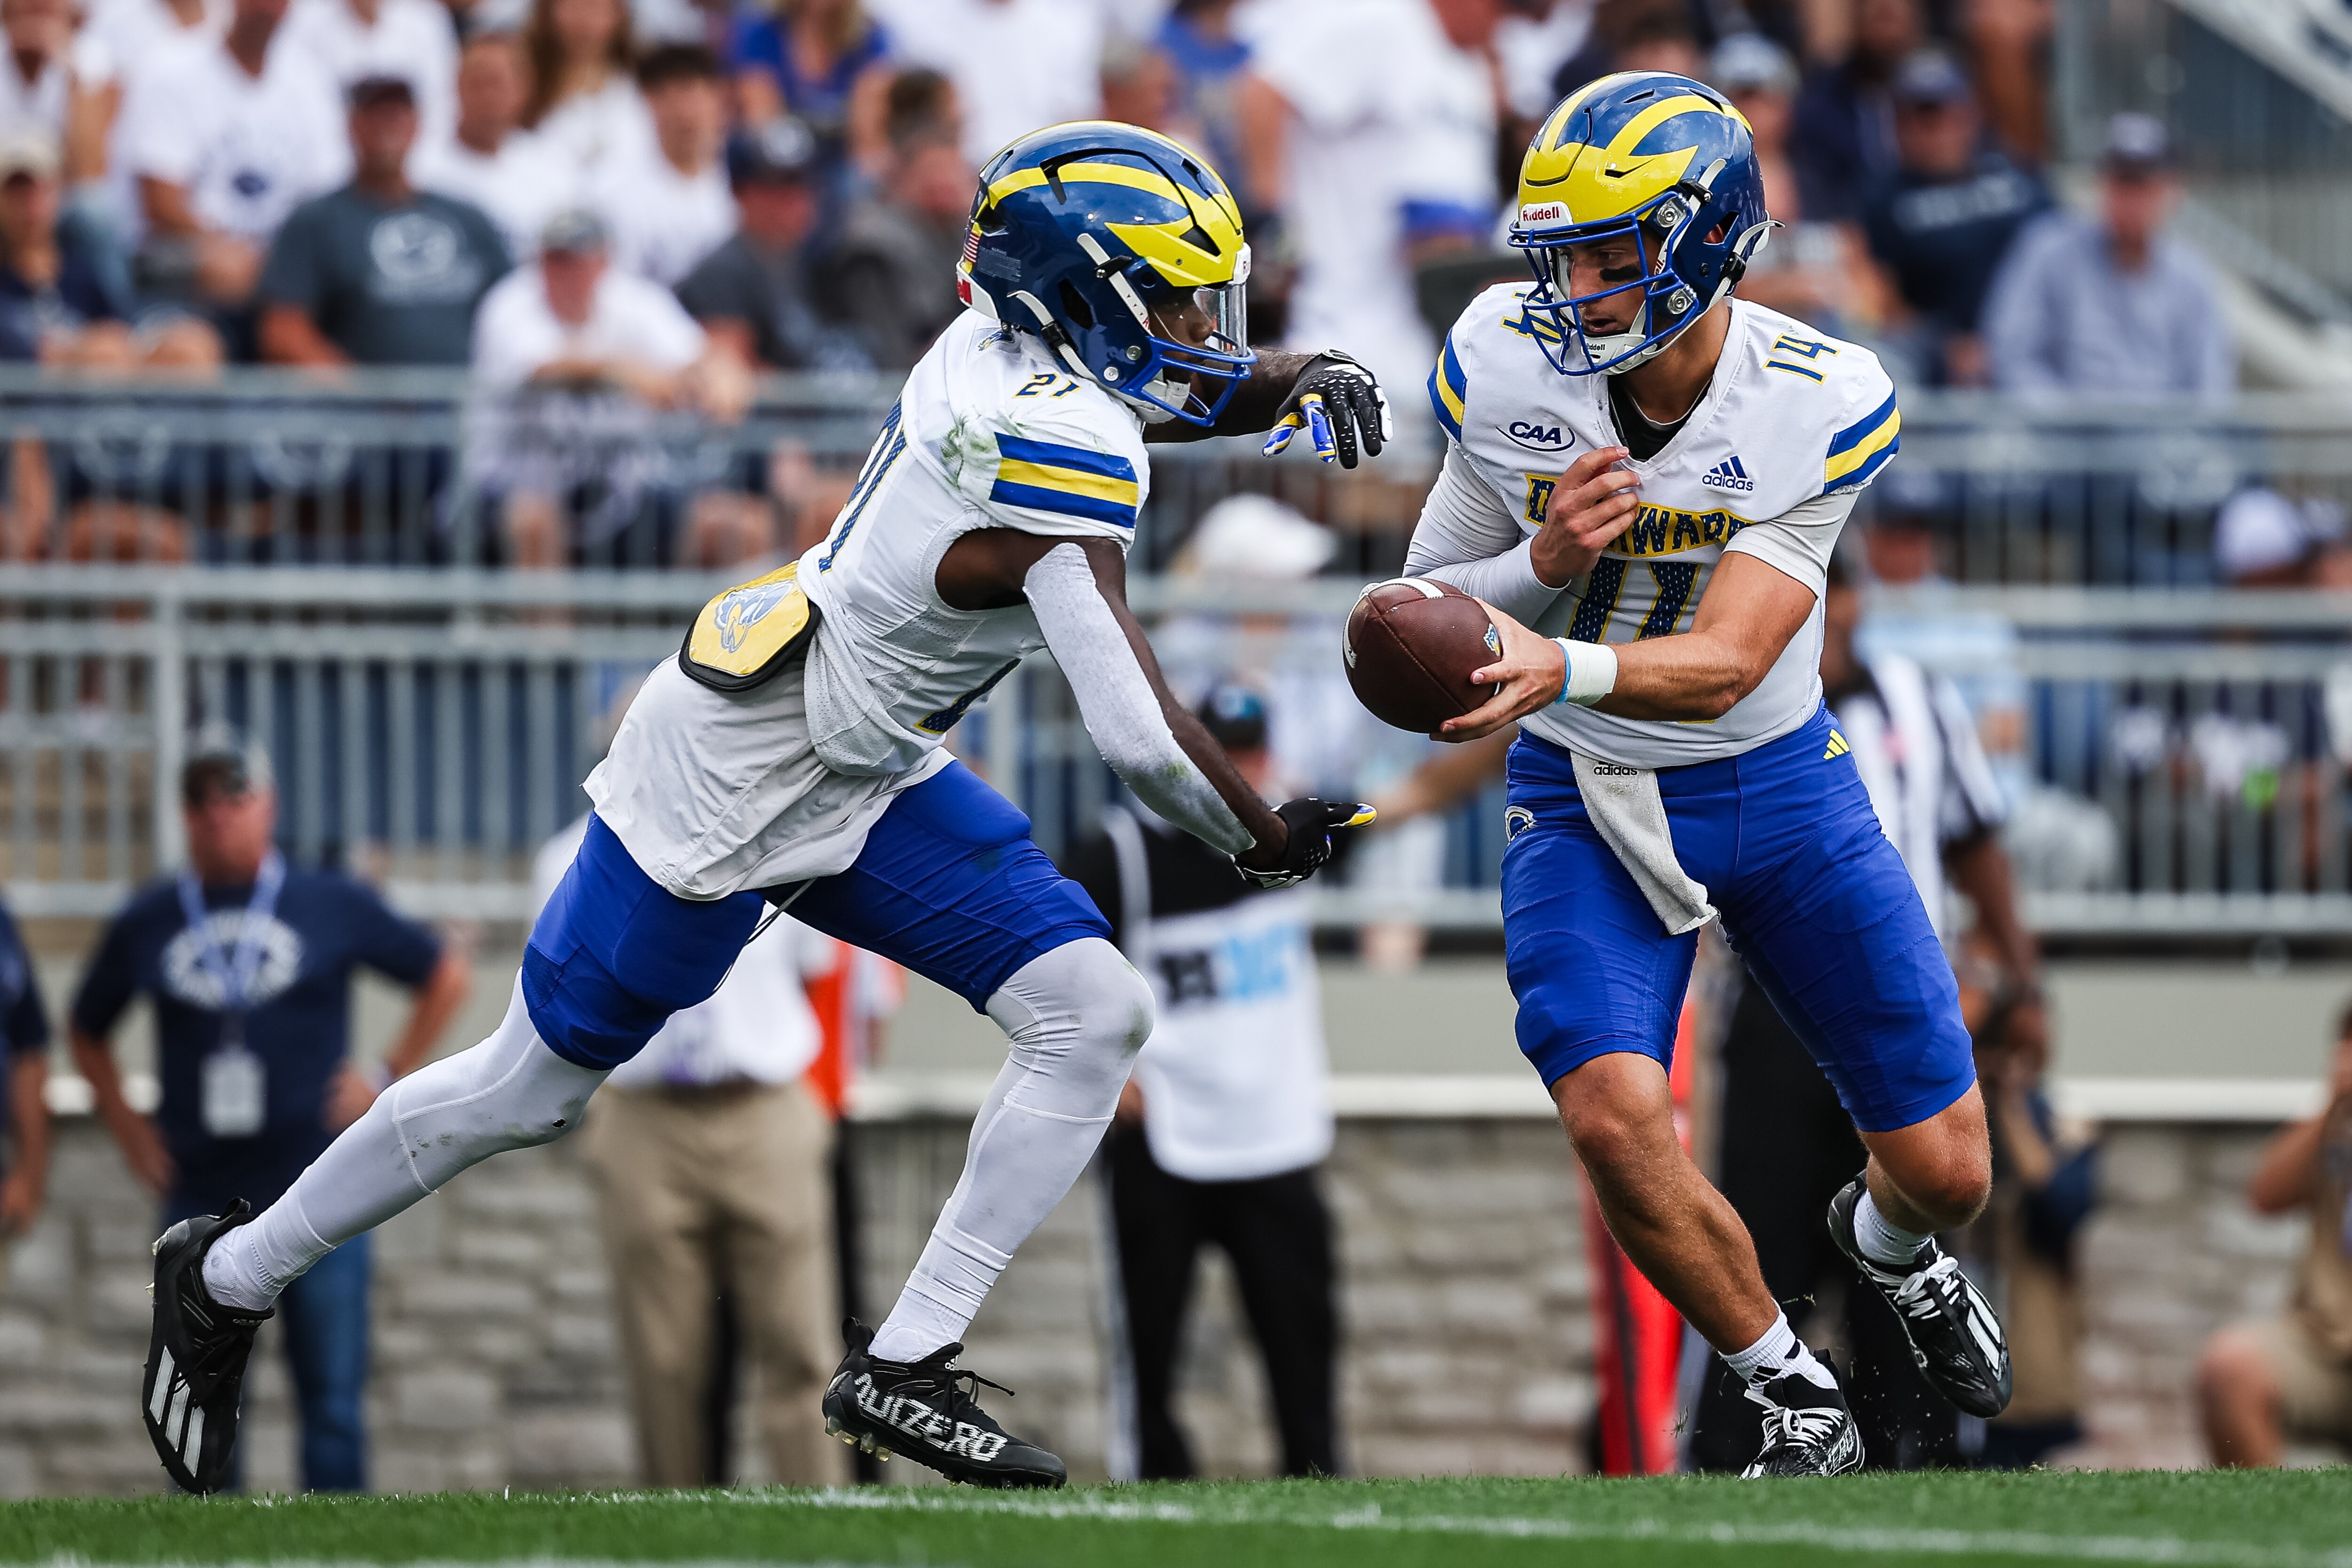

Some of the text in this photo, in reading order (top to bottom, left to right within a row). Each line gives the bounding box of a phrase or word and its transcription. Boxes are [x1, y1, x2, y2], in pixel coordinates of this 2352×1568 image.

[1523, 206, 1559, 221] Riddell
[1762, 333, 1841, 386] 14
[1012, 373, 1082, 399] 21
[1509, 421, 1562, 445] CAA
[1702, 474, 1754, 491] adidas
[1525, 473, 1757, 557] DWAR
[1593, 763, 1638, 775] adidas
